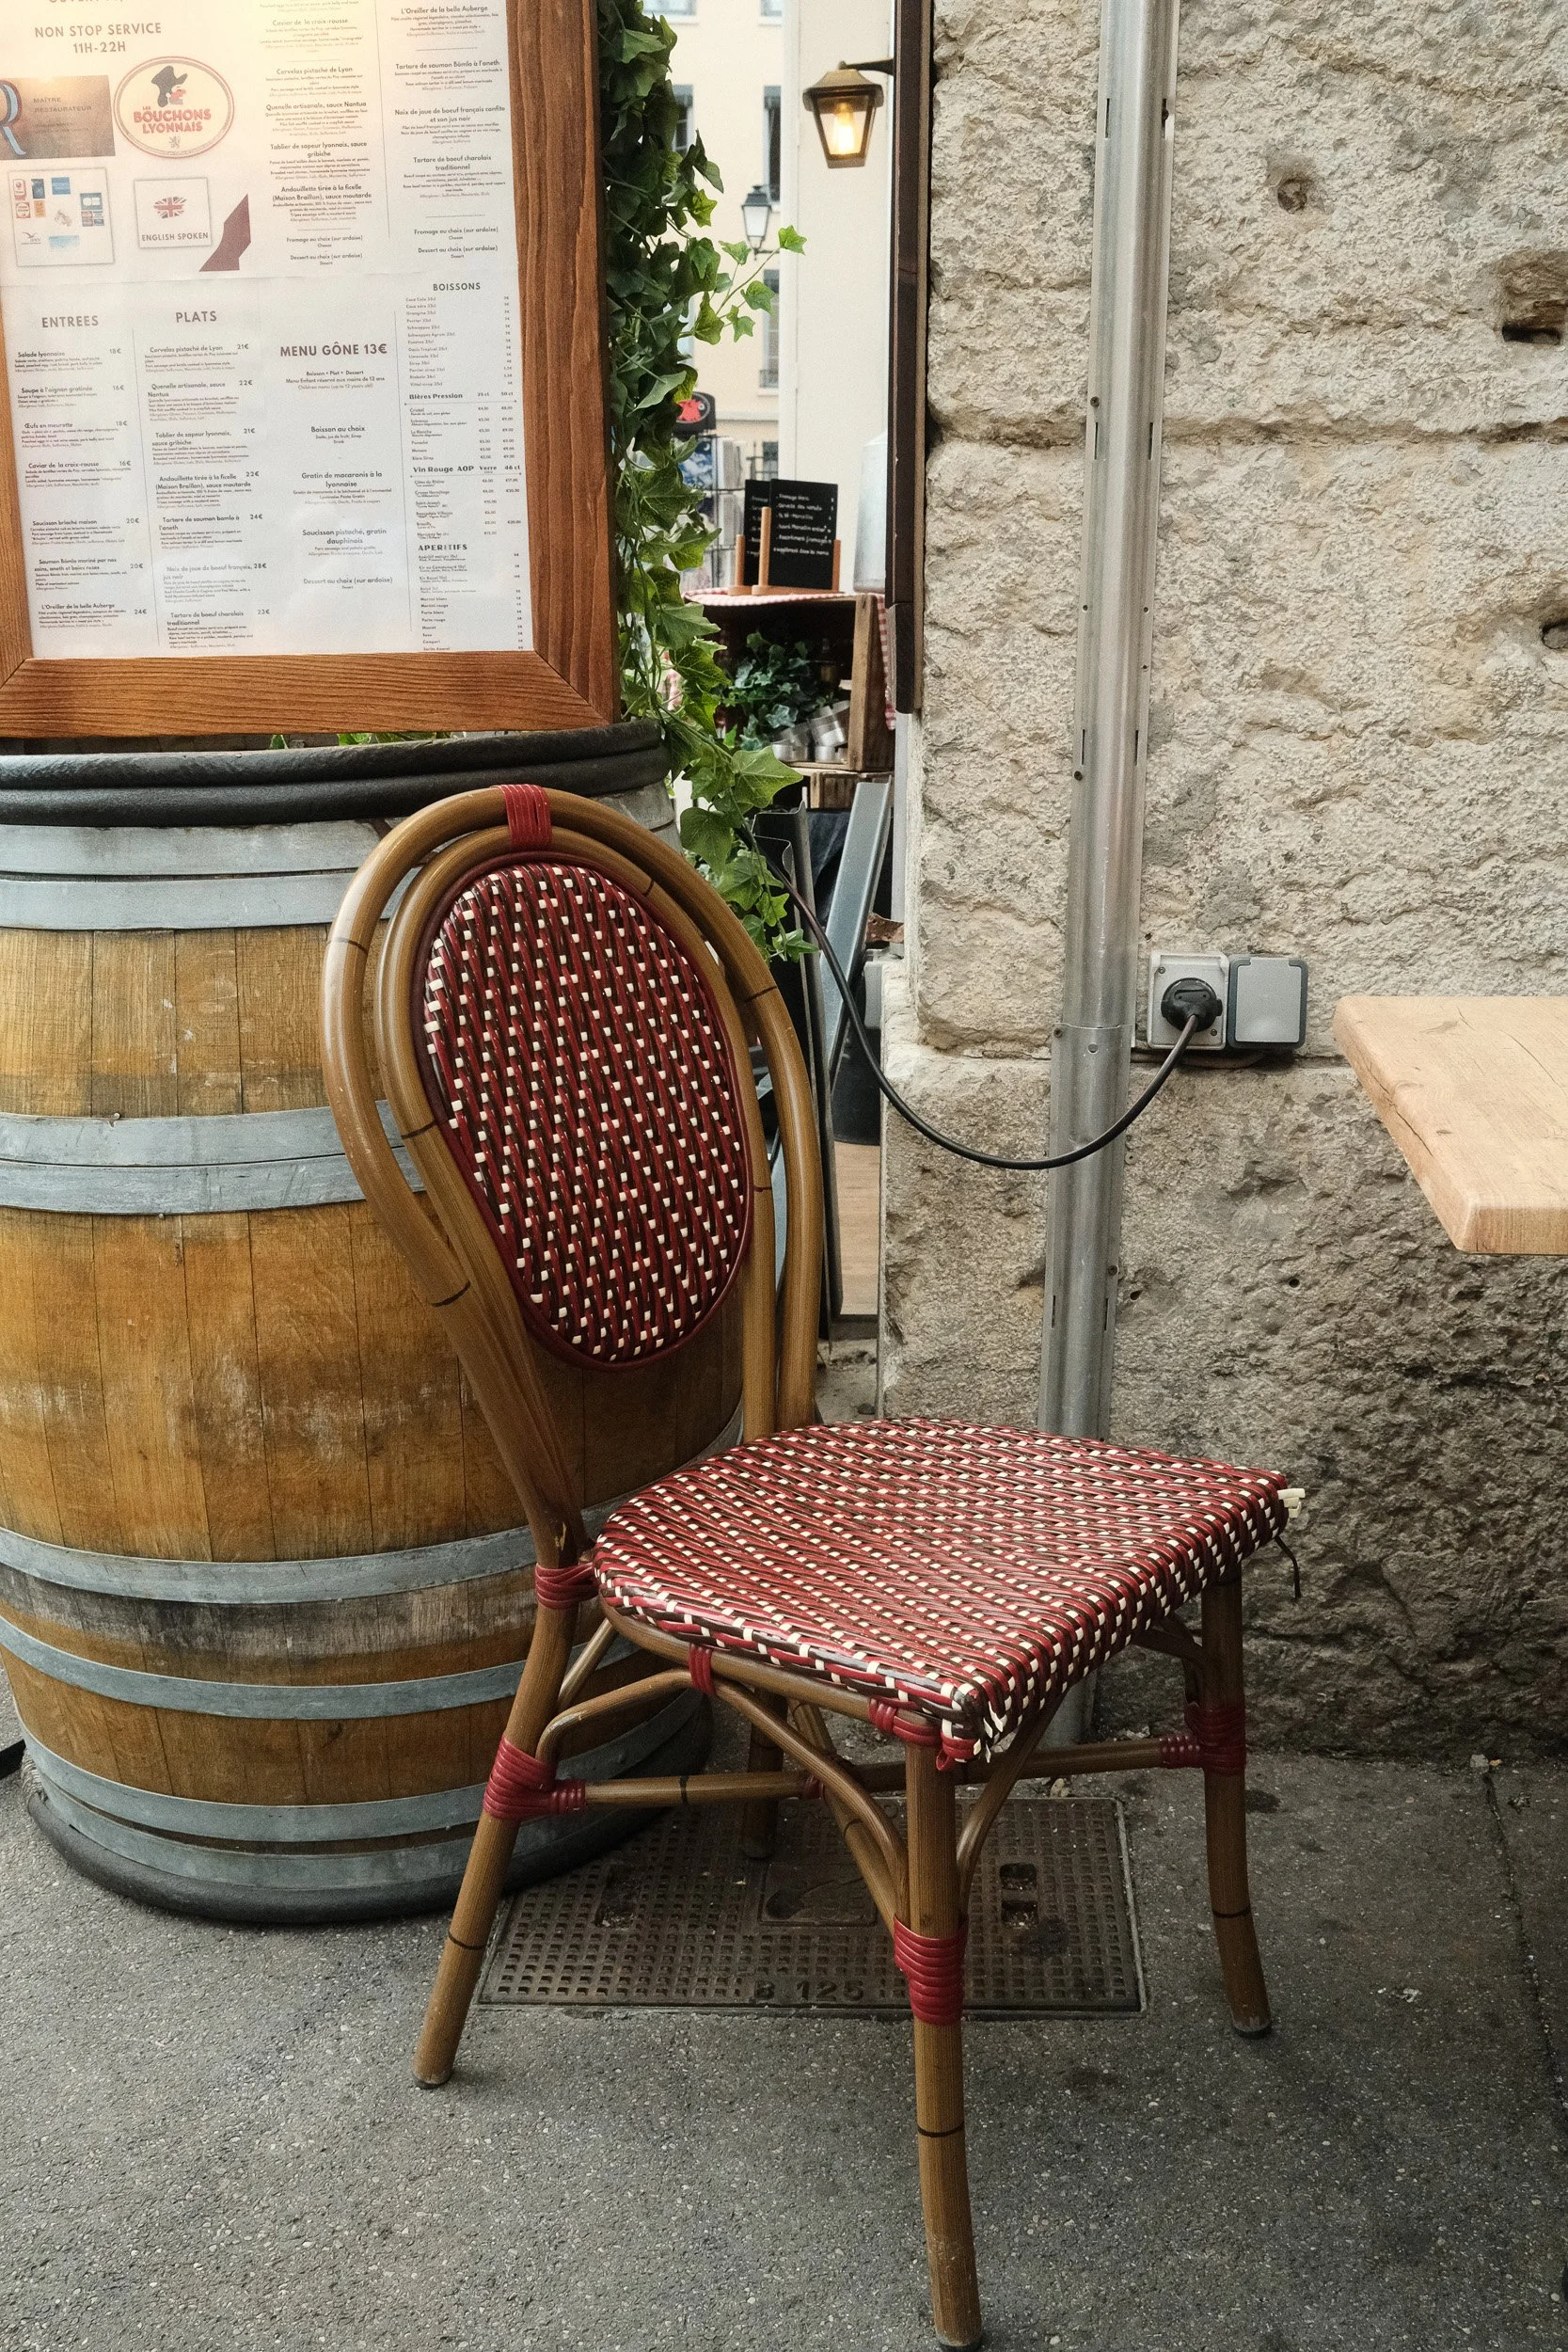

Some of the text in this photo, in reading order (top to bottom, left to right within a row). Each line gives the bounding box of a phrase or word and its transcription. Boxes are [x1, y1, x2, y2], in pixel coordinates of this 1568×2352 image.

[462, 5, 488, 13] Auberge
[35, 23, 162, 38] NON STOP SERVICE
[73, 41, 126, 54] 11H-22H
[293, 102, 325, 110] artisanale,
[419, 107, 432, 116] joue
[460, 105, 484, 114] français
[134, 108, 211, 123] BOUCHONS
[449, 115, 458, 123] jus
[142, 121, 203, 134] LYONNAIS
[323, 141, 350, 150] lyonnais,
[273, 194, 296, 202] (Maison
[296, 193, 325, 201] Braillon),
[414, 228, 439, 236] Fromage
[475, 226, 499, 234] ardoise)
[142, 231, 209, 242] ENGLISH SPOKEN
[475, 245, 498, 253] ardoise)
[433, 282, 481, 291] BOISSONS
[41, 315, 99, 327] ENTREES
[176, 310, 217, 323] PLATS
[176, 344, 199, 353] pistaché
[209, 343, 223, 352] Lyon
[280, 342, 388, 357] MENU GÔNE 13€
[38, 350, 65, 358] lyonnaise
[428, 466, 453, 474] Rouge
[335, 528, 365, 536] pistaché,
[327, 537, 363, 546] dauphinois
[797, 1979, 864, 2002] 125
